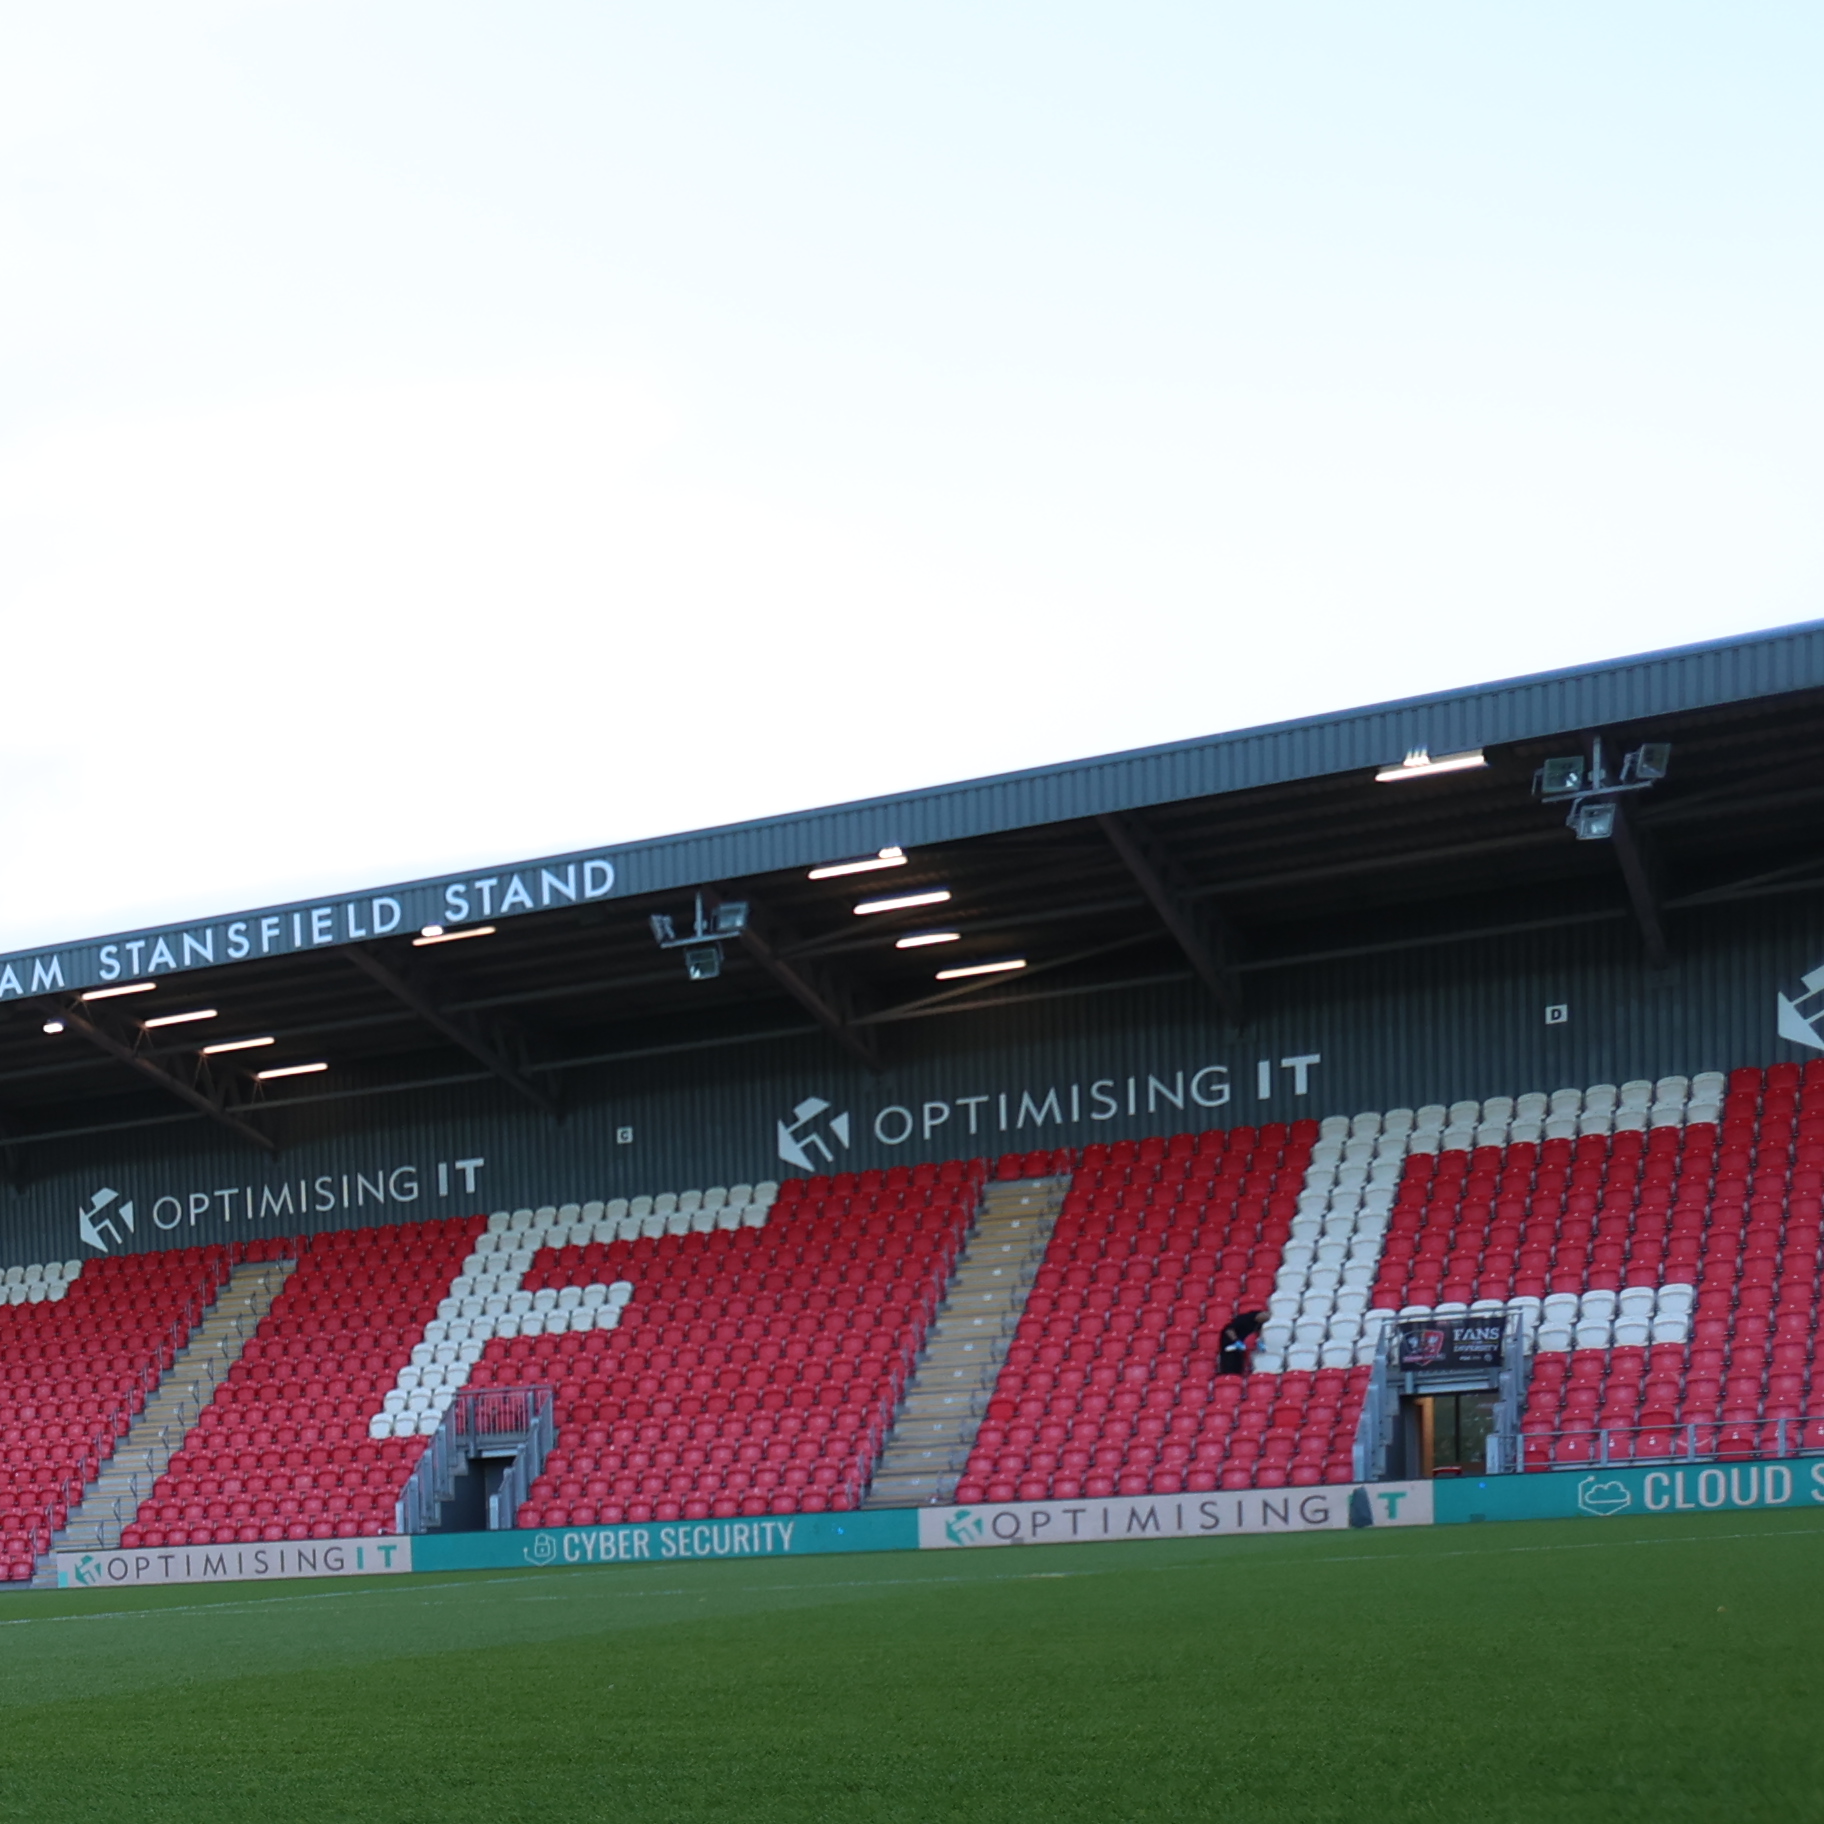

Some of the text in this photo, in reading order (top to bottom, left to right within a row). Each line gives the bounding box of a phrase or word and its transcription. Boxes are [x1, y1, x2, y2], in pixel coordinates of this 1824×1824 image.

[99, 897, 401, 981] STANSFIELD
[444, 859, 615, 922] STAND
[874, 1053, 1321, 1145] OPTIMISING IT
[152, 1158, 485, 1230] OPTIMISING IT
[1452, 1327, 1501, 1341] FANS
[1643, 1465, 1793, 1510] CLOUD
[991, 1494, 1330, 1540] OPTIMISING
[107, 1545, 397, 1581] OPTIMISING IT
[563, 1521, 795, 1562] CYBER SECURITY
